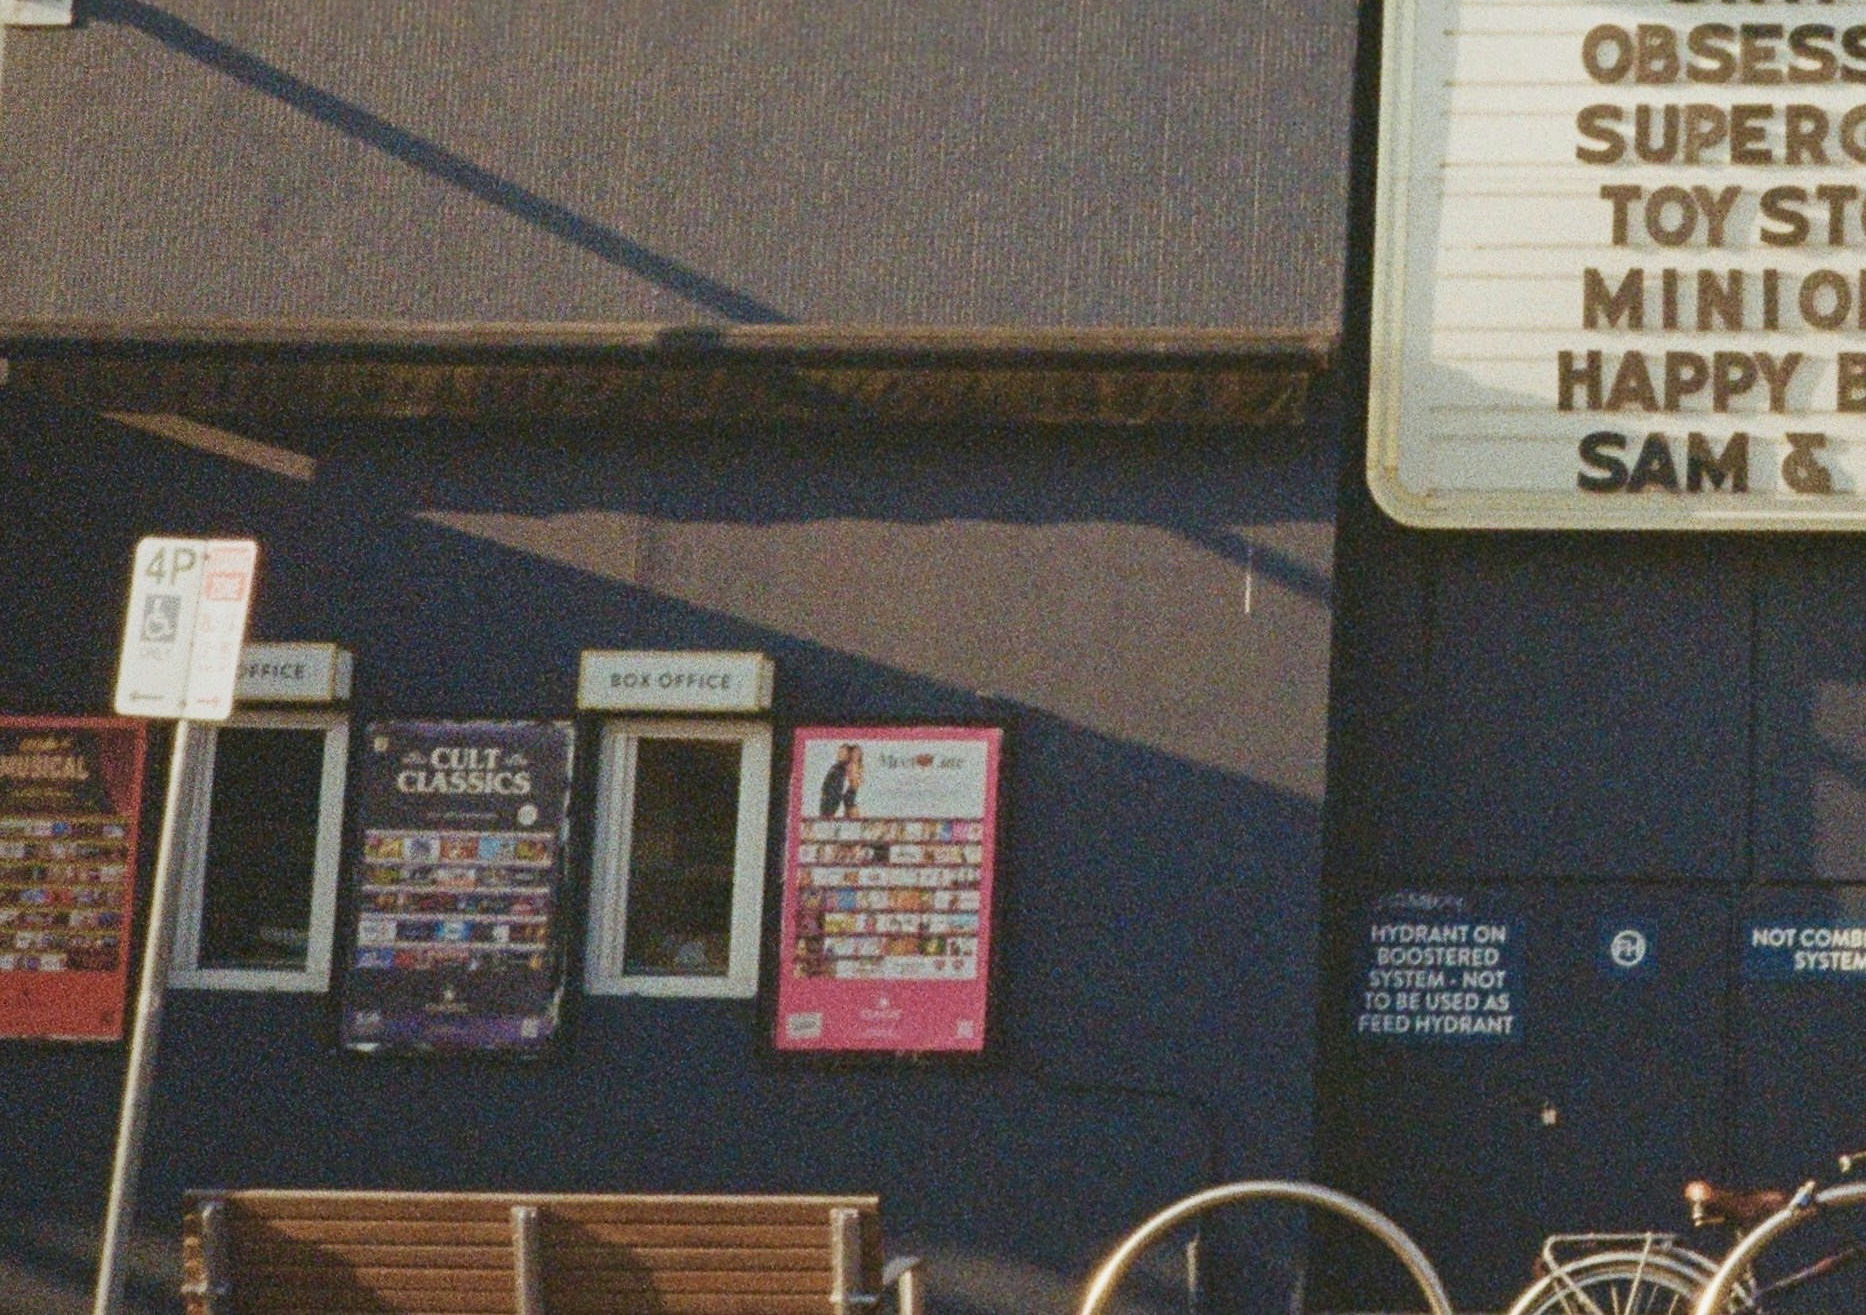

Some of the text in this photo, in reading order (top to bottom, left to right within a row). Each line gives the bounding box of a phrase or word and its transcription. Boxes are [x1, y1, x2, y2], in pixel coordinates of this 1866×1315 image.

[1600, 185, 1741, 248] TOY
[1557, 350, 1802, 414] HAPPY
[1576, 431, 1750, 494] SAM
[1782, 433, 1834, 496] &
[145, 546, 196, 586] 4P
[610, 672, 731, 689] BOX OFFICE
[430, 746, 502, 770] CULT
[396, 770, 533, 795] CLASSICS
[1370, 924, 1506, 943] HYDRANT ON
[1752, 928, 1797, 947] NOT
[1377, 947, 1500, 966] BOOSTERED
[1369, 970, 1445, 988] SYSTEM
[1462, 970, 1507, 988] NOT
[1364, 992, 1511, 1012] TO BE USED AS
[1358, 1015, 1514, 1034] FEED HYDRANT
